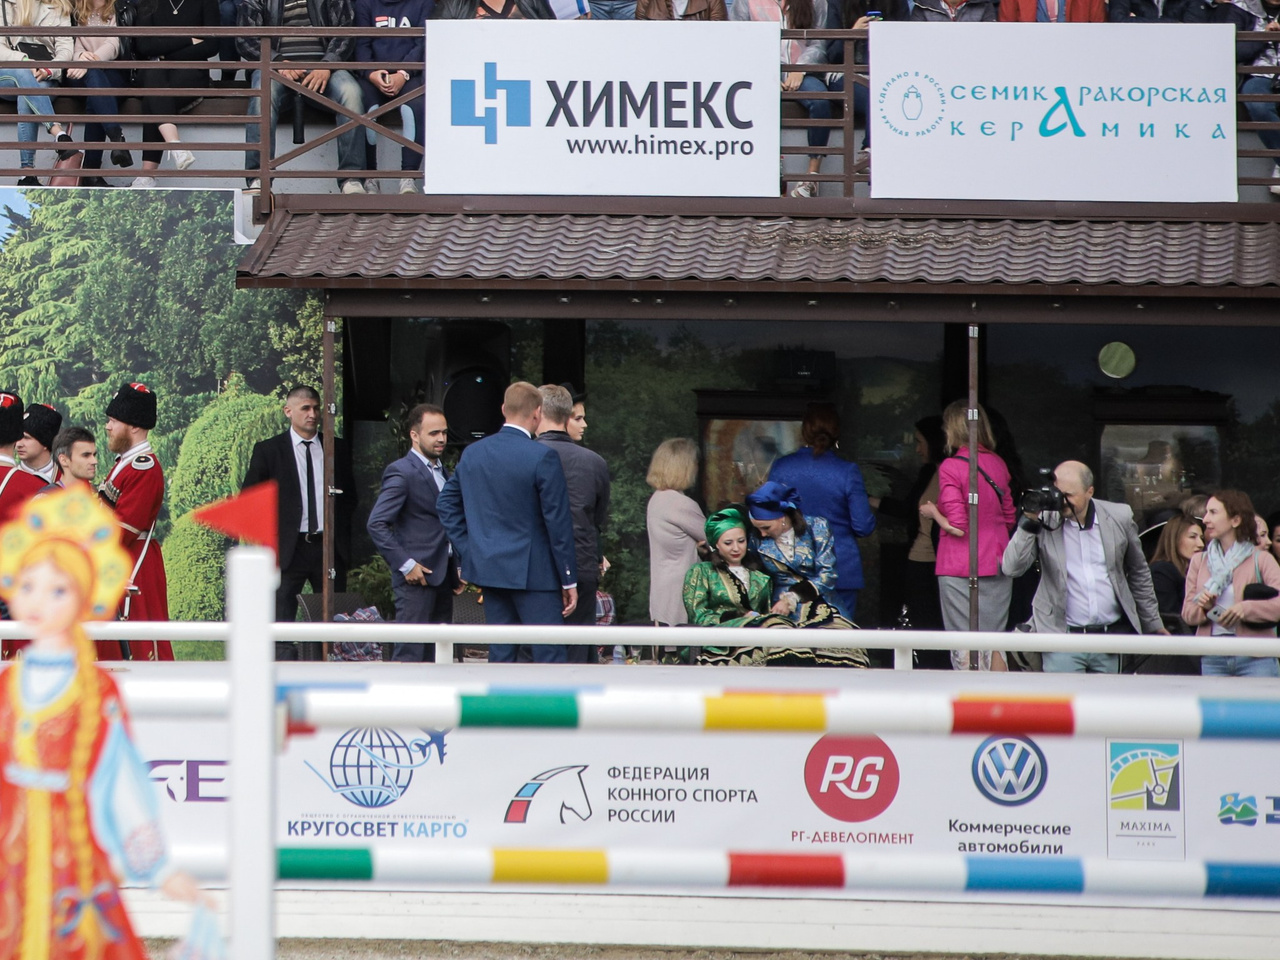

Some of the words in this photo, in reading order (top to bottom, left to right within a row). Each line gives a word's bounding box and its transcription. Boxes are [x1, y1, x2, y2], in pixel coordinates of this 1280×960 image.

[923, 74, 946, 105] РОССИИ
[545, 80, 754, 130] ХИМЕКС
[916, 115, 945, 137] РАБОТА
[566, 134, 754, 160] www.himex.pro
[607, 766, 710, 782] ФЕДЕРАЦИЯ
[608, 787, 687, 801] КОННОГО
[692, 789, 758, 803] СПОРТА
[608, 809, 675, 823] РОССИИ
[287, 820, 398, 838] КРУГОСВЕТ
[403, 822, 467, 838] КАРГО
[948, 819, 1071, 836] Коммерческие
[1120, 821, 1172, 832] MAXIMA
[792, 830, 914, 845] РГ-ДЕВЕЛОПМЕНТ
[958, 840, 1063, 855] автомобили
